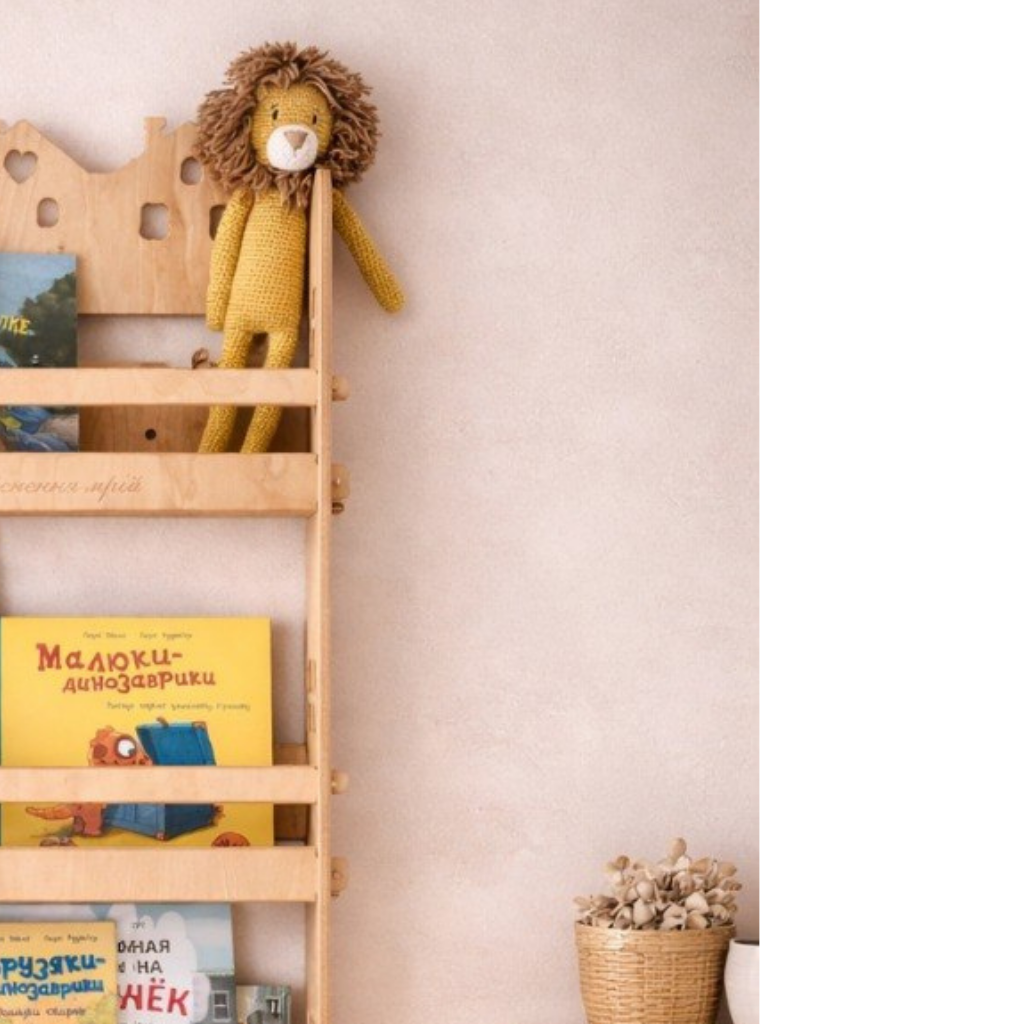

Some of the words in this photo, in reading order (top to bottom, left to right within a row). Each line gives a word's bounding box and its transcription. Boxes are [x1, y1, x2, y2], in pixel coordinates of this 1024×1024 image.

[36, 643, 183, 672] Малюки-
[62, 671, 216, 693] динозаврики
[118, 977, 190, 1016] НЁК
